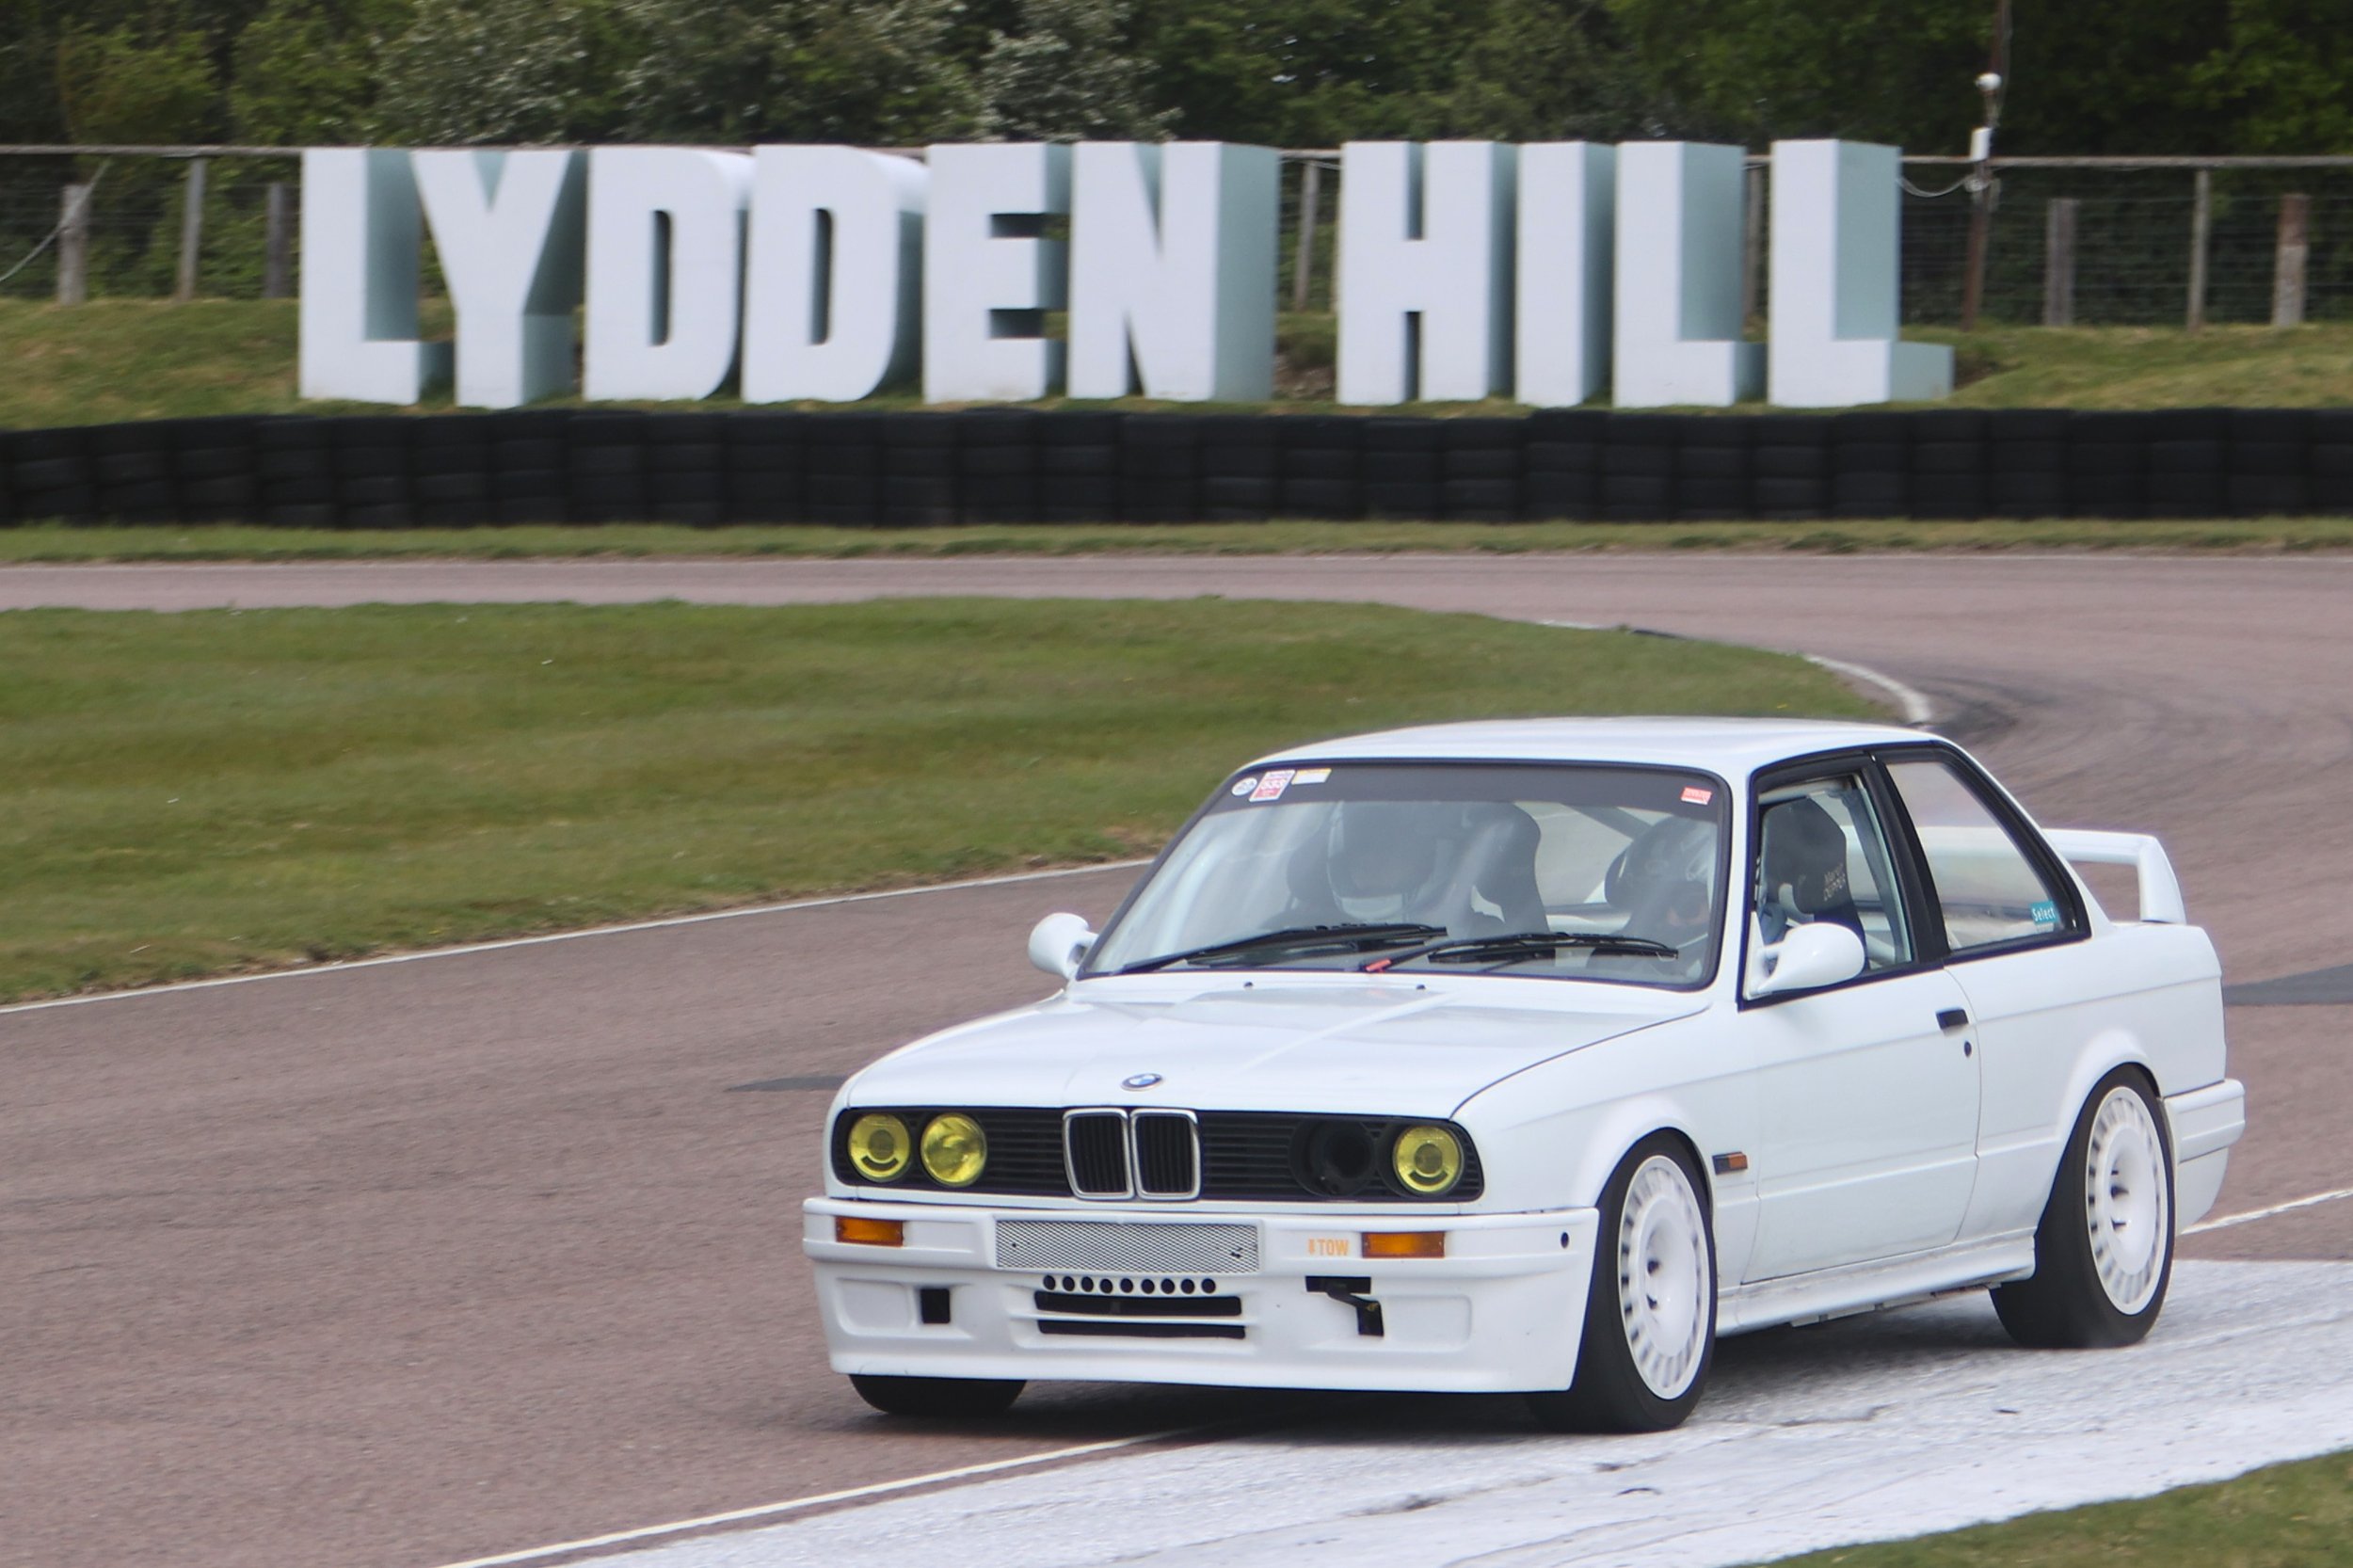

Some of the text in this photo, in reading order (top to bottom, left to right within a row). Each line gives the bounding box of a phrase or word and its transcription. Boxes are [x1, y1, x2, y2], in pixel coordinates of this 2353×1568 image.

[298, 138, 1901, 408] LYDDEN HILL
[2032, 906, 2056, 922] Select
[1317, 1238, 1349, 1256] TOW
